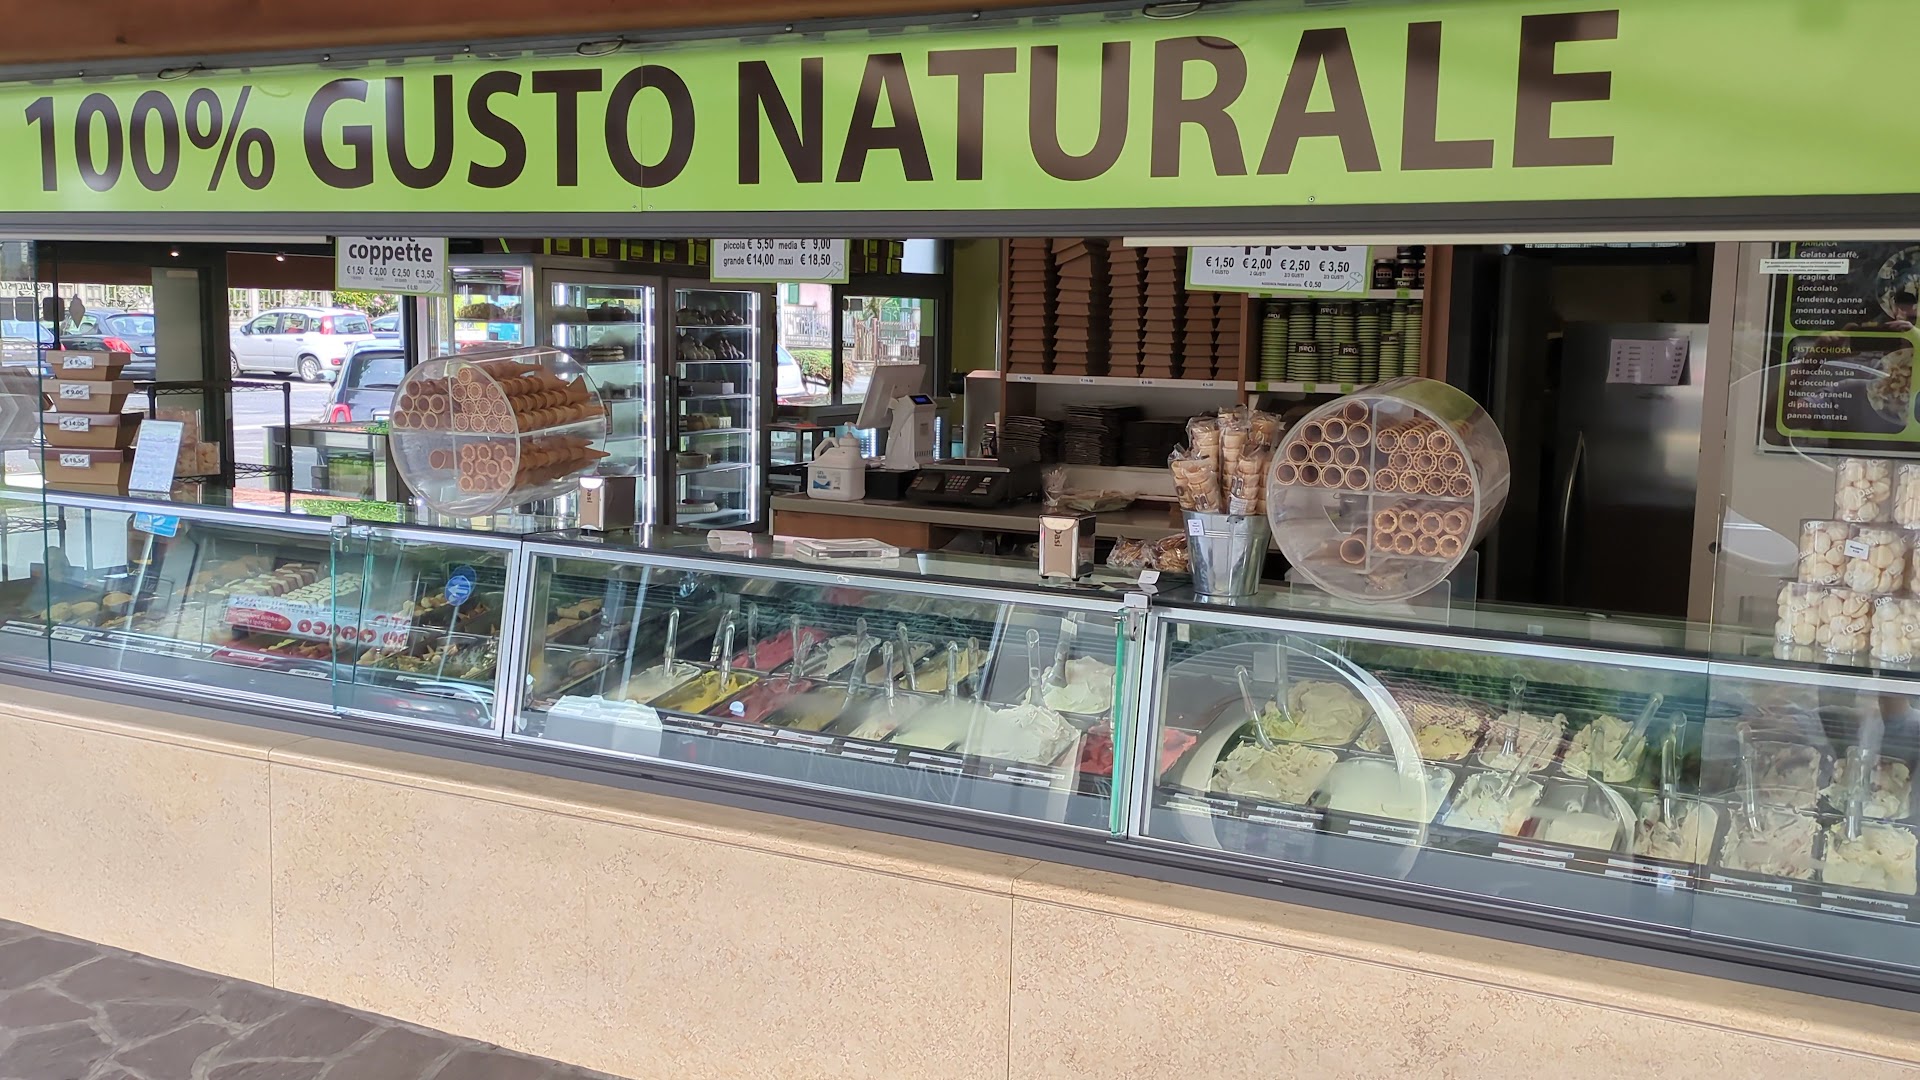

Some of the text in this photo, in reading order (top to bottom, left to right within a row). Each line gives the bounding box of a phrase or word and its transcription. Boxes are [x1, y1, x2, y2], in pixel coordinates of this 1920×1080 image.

[25, 9, 1620, 192] 100% GUSTO NATURALE
[723, 241, 746, 251] piccola
[757, 239, 774, 251] 5,50
[778, 240, 798, 250] media
[813, 239, 831, 251] 9,00
[348, 243, 433, 266] coppette
[1800, 251, 1860, 260] Gelato al caffè,
[723, 255, 745, 267] grande
[753, 254, 775, 267] 14,00
[778, 256, 794, 266] maxi
[808, 254, 831, 267] 18,50
[1214, 257, 1235, 270] 1,50
[1251, 258, 1272, 271] 2,00
[1289, 260, 1311, 273] 2,50
[1327, 261, 1350, 274] 3,50
[352, 266, 365, 276] 1,50
[374, 267, 388, 277] 2,00
[397, 268, 411, 278] 2,50
[420, 269, 435, 280] 3,50
[1796, 296, 1836, 304] fondente,
[1794, 318, 1836, 326] cioccolato
[1792, 346, 1852, 354] PISTACCHIOSA
[1791, 357, 1818, 365] Gelato
[1790, 368, 1855, 377] pistacchio, salsa
[1788, 390, 1853, 399] bianco, granella
[1797, 401, 1833, 410] pistacchi
[1786, 412, 1848, 421] panna montata
